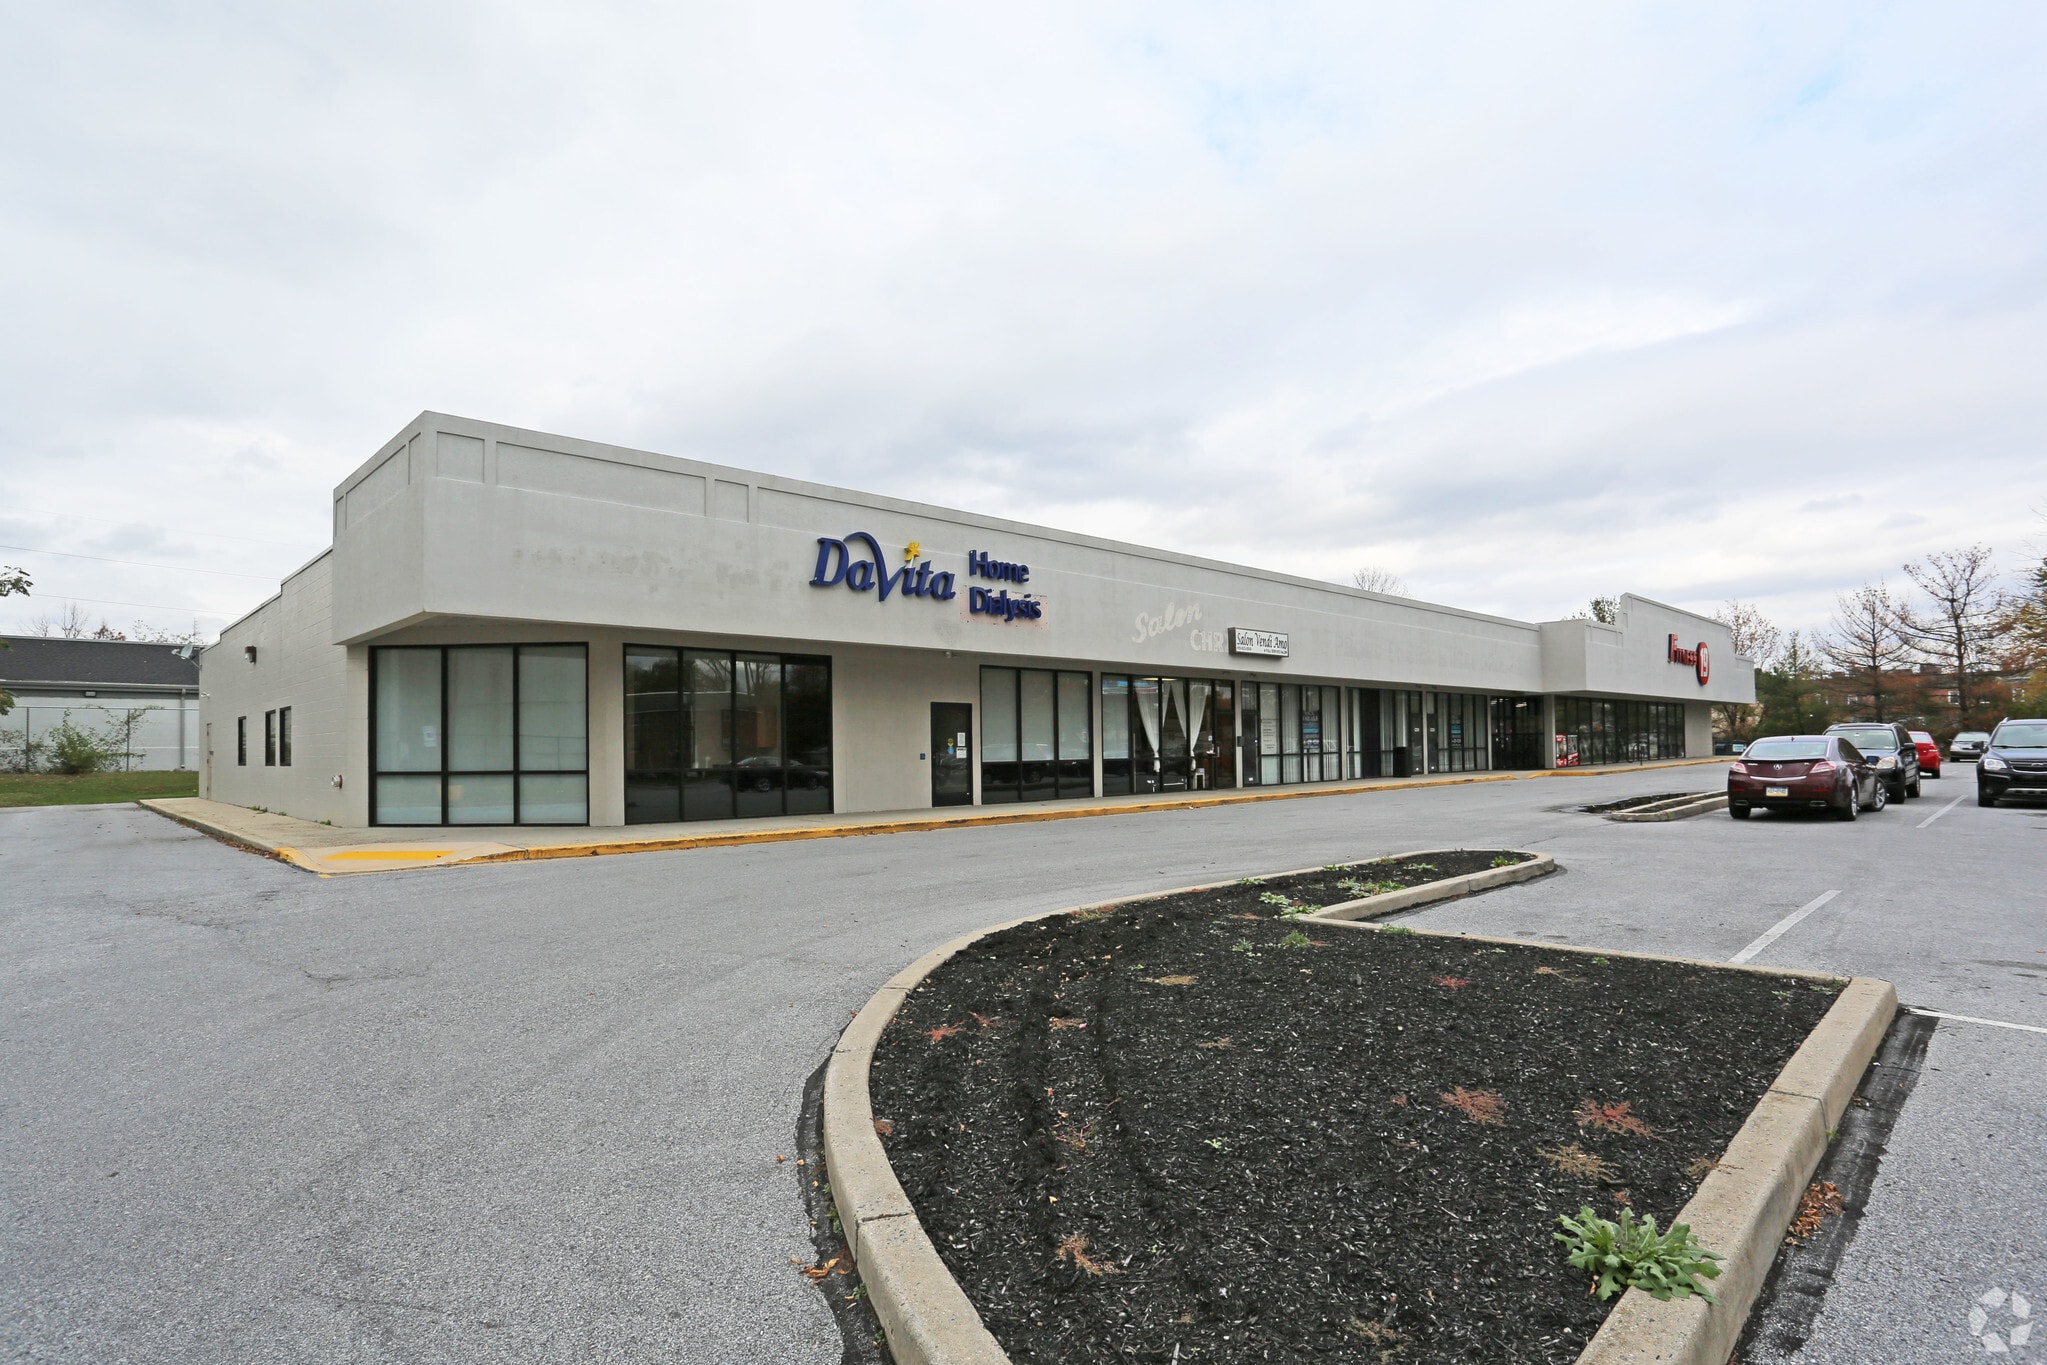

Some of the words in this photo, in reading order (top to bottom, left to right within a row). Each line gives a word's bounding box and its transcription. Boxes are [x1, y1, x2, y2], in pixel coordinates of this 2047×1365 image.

[809, 531, 956, 602] DaVita
[969, 549, 1030, 584] Home
[969, 586, 1042, 622] Dialysis
[1132, 602, 1202, 643] Salon
[1236, 631, 1253, 647] Salon
[1700, 647, 1708, 678] 19
